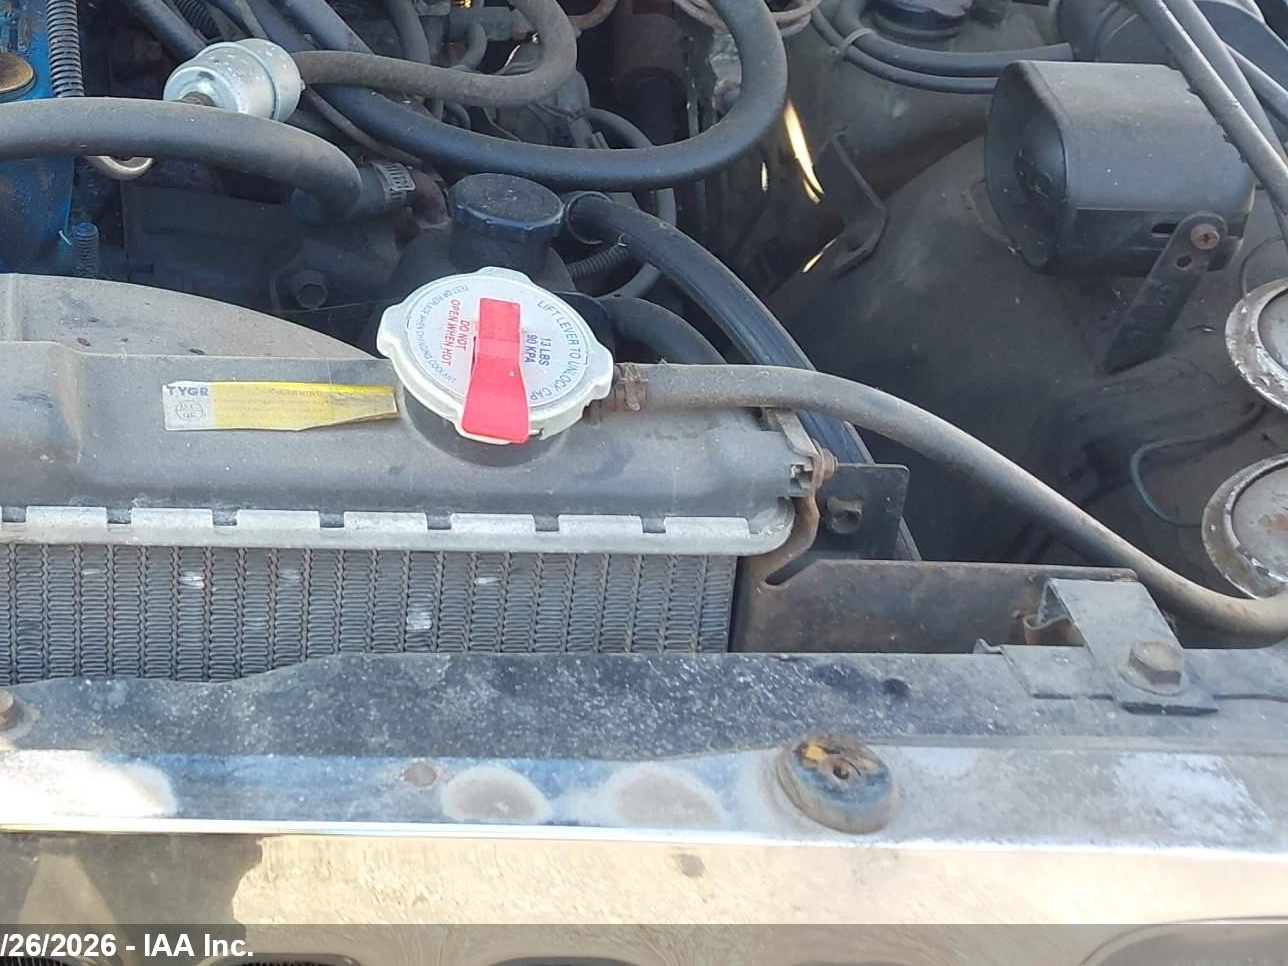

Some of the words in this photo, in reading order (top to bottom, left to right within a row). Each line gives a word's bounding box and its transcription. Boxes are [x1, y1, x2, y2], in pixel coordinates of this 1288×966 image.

[448, 299, 461, 323] OPEN
[537, 300, 561, 316] LIFT
[459, 320, 471, 332] DO
[556, 317, 580, 345] LEVER
[443, 323, 457, 347] WHEN
[455, 333, 468, 351] NOT
[526, 334, 538, 345] 90
[540, 337, 552, 346] 13
[440, 348, 453, 366] HOT
[524, 345, 537, 362] KPA
[538, 348, 551, 366] LBS
[568, 347, 581, 359] TO
[552, 360, 581, 392] UNLOCK
[530, 387, 552, 400] CAP
